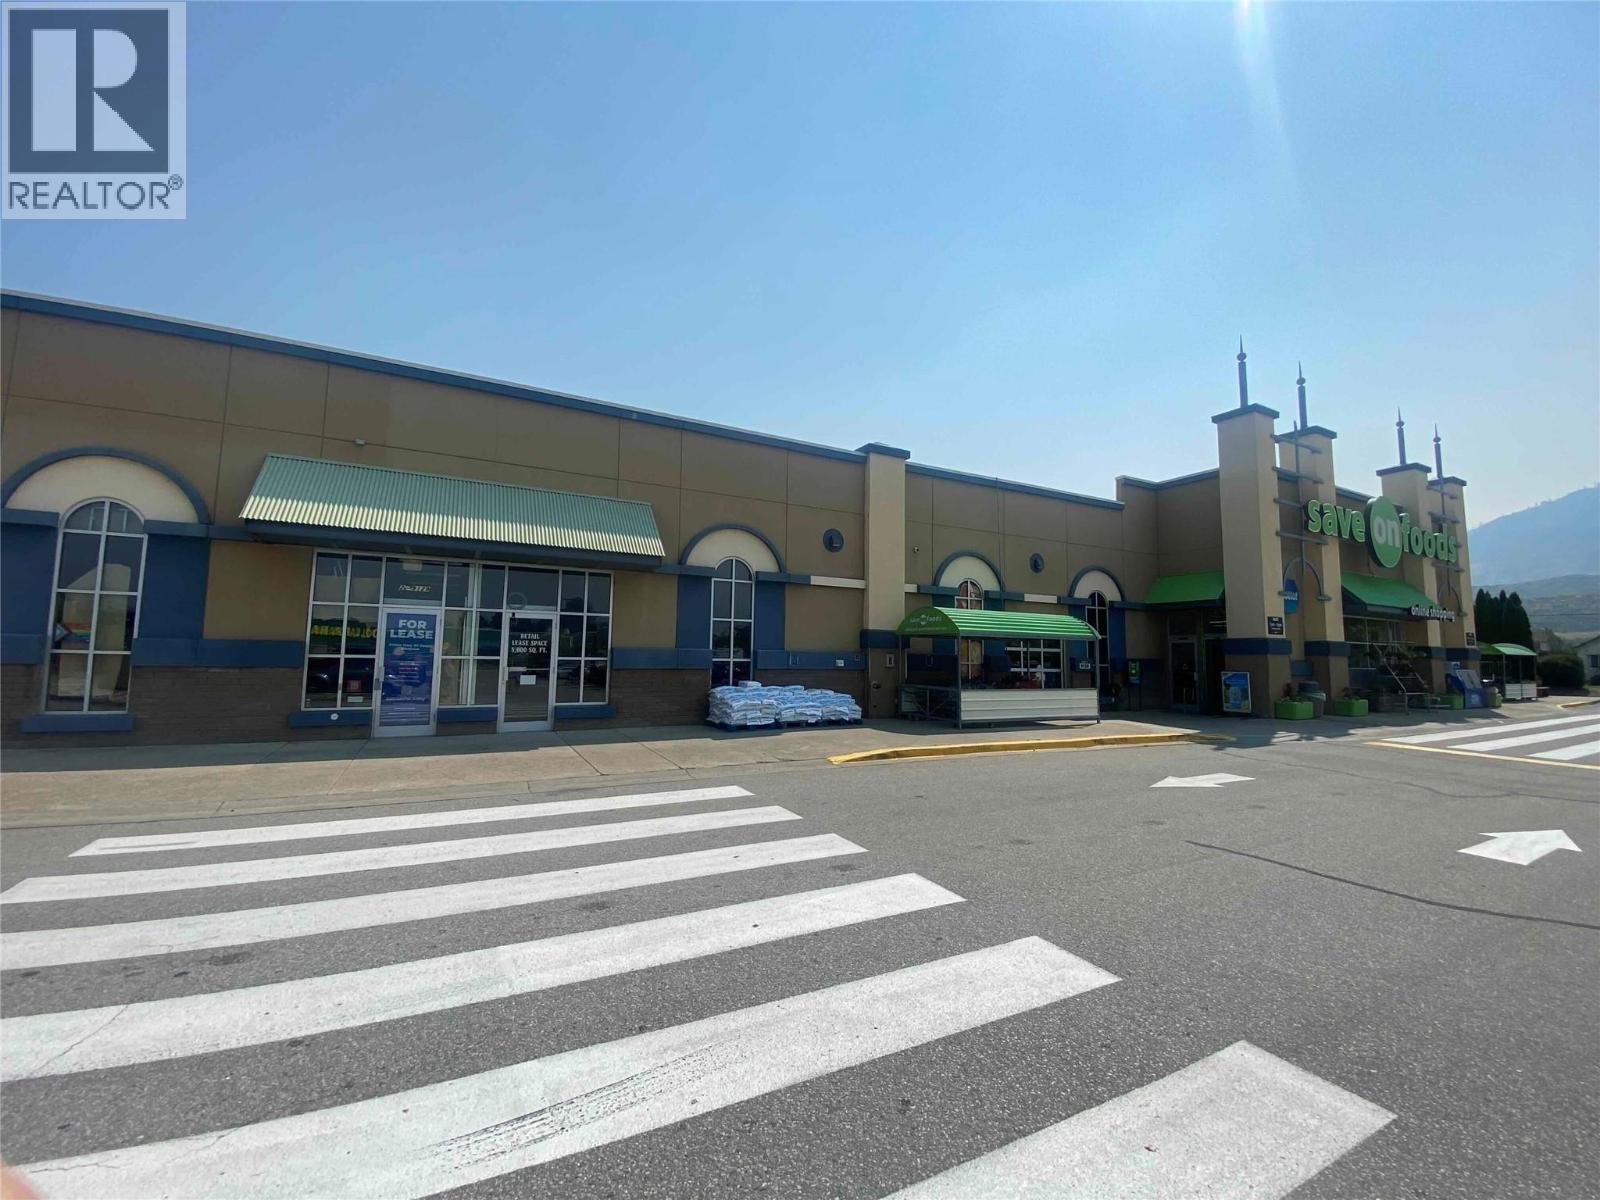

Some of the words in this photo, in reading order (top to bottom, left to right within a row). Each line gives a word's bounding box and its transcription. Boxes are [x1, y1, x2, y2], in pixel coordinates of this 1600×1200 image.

[1307, 500, 1366, 543] save
[1373, 516, 1399, 547] on
[1399, 513, 1457, 563] foods
[398, 619, 427, 628] FOR
[389, 629, 433, 639] LEASE
